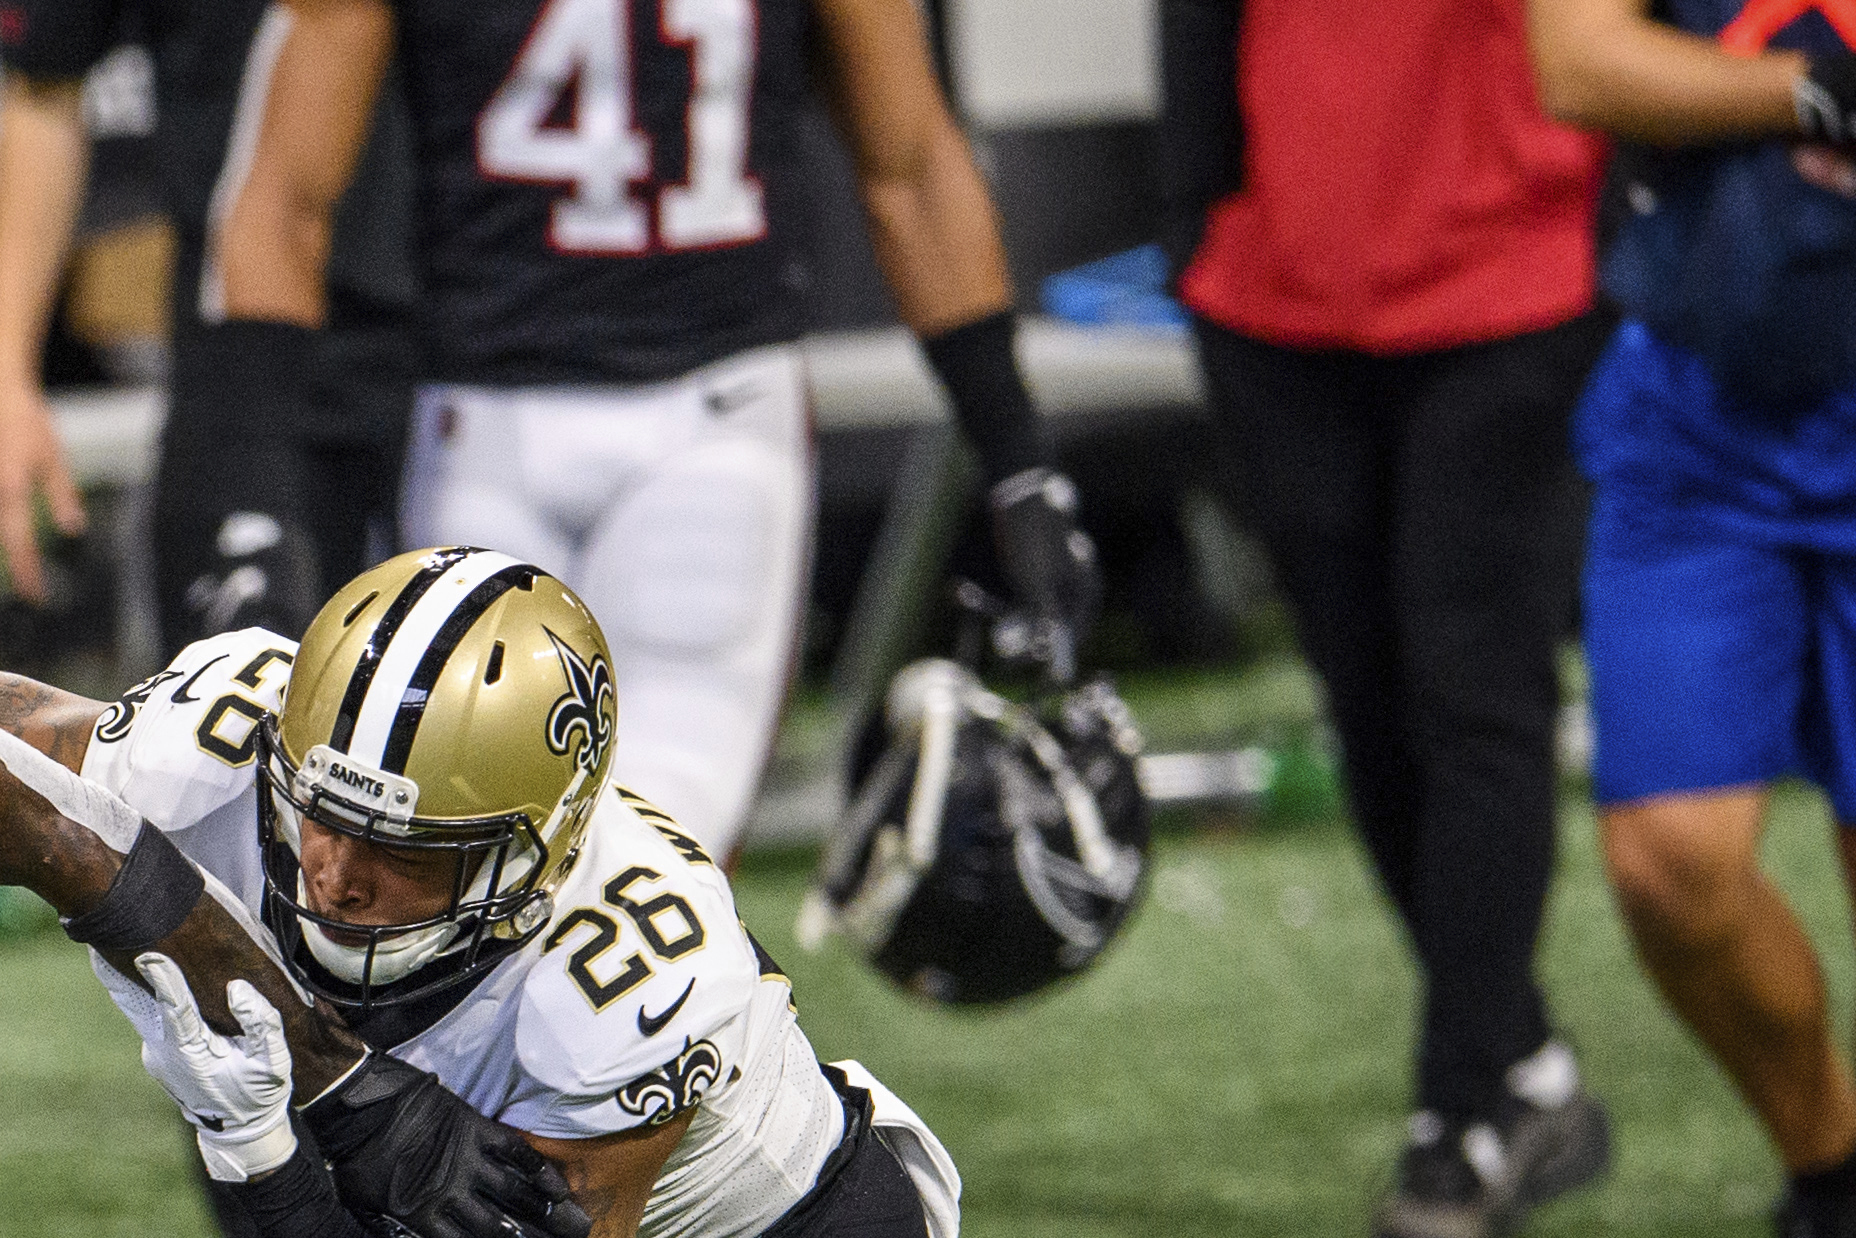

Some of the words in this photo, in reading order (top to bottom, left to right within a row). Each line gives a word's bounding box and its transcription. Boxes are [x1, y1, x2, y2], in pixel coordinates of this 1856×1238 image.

[474, 0, 768, 258] 41
[328, 761, 386, 799] SAINTS
[540, 864, 708, 1015] 26
